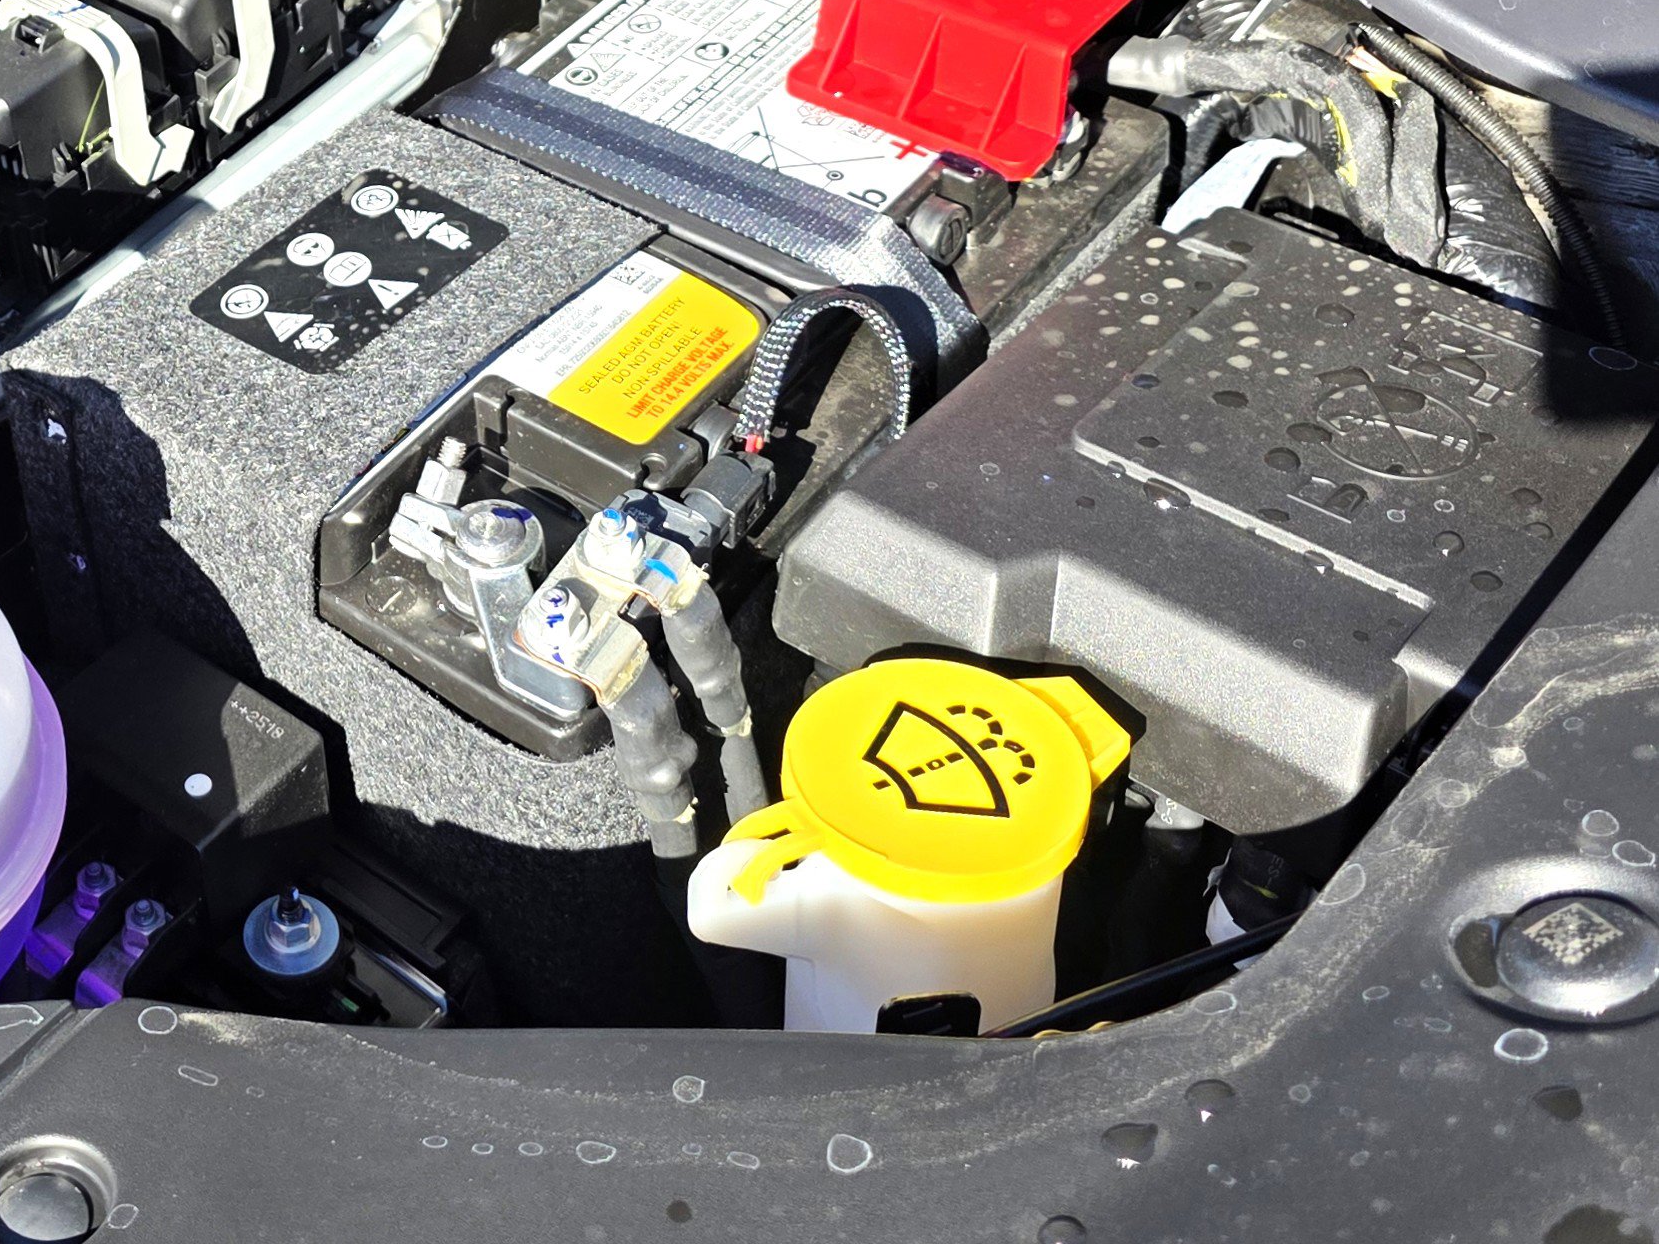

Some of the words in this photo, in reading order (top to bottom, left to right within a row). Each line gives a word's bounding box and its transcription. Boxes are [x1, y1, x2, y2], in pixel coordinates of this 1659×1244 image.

[578, 356, 621, 394] SEALED
[616, 335, 645, 359] AGM
[638, 296, 686, 338] BATTERY
[610, 367, 632, 384] DO
[626, 348, 653, 369] NOT
[647, 320, 683, 350] OPEN!
[622, 326, 702, 398] NON-SPILLABLE
[625, 392, 657, 418] LIMIT
[650, 360, 690, 395] CHARGE
[683, 325, 728, 364] VOLTAGE
[645, 404, 665, 419] TO
[659, 385, 684, 406] 14.4
[678, 359, 712, 388] VOLTS
